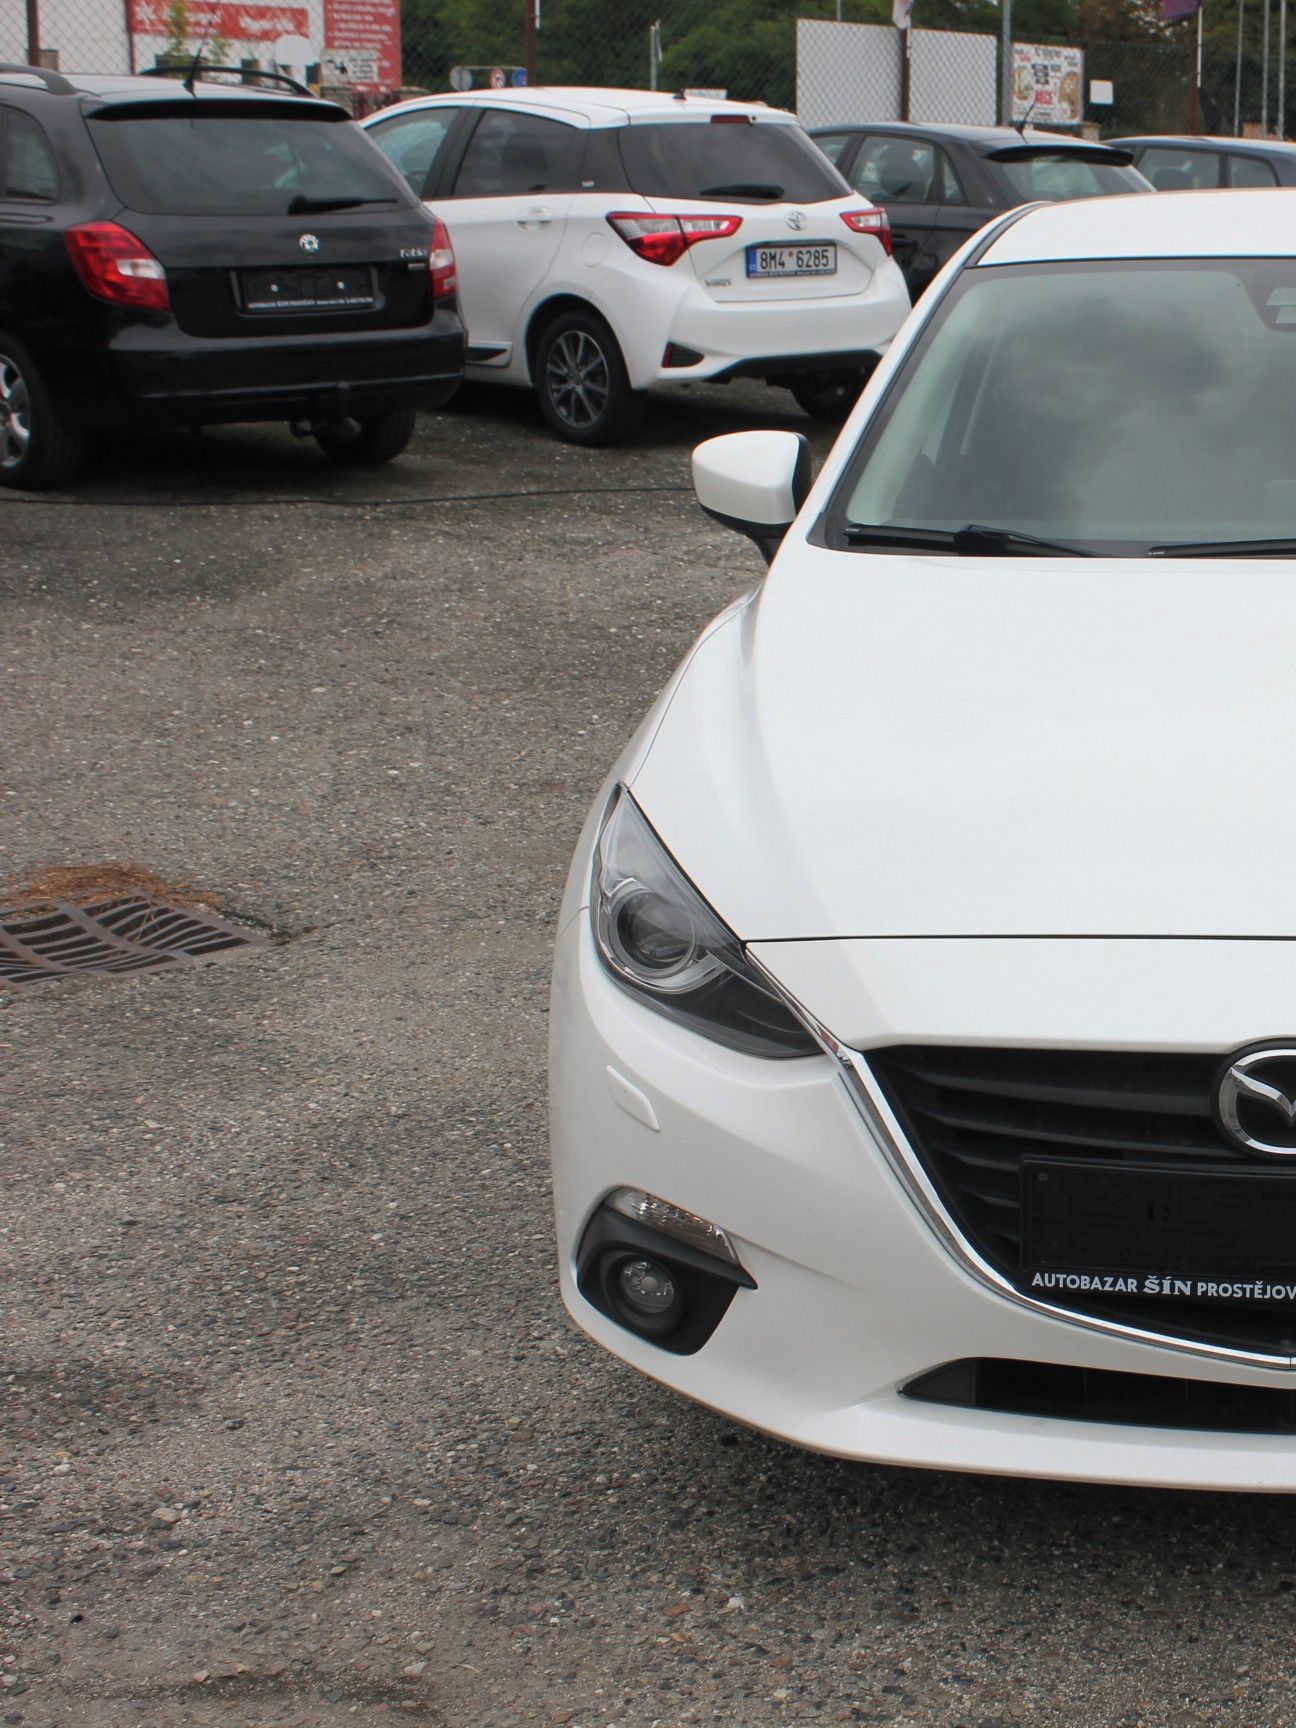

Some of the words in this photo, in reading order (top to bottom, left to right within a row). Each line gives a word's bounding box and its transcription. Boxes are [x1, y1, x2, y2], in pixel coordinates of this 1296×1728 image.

[760, 251, 785, 270] 8M4
[796, 249, 829, 269] 6285
[1031, 1272, 1138, 1293] AUTOBAZAR
[1143, 1275, 1192, 1296] ŠÍN
